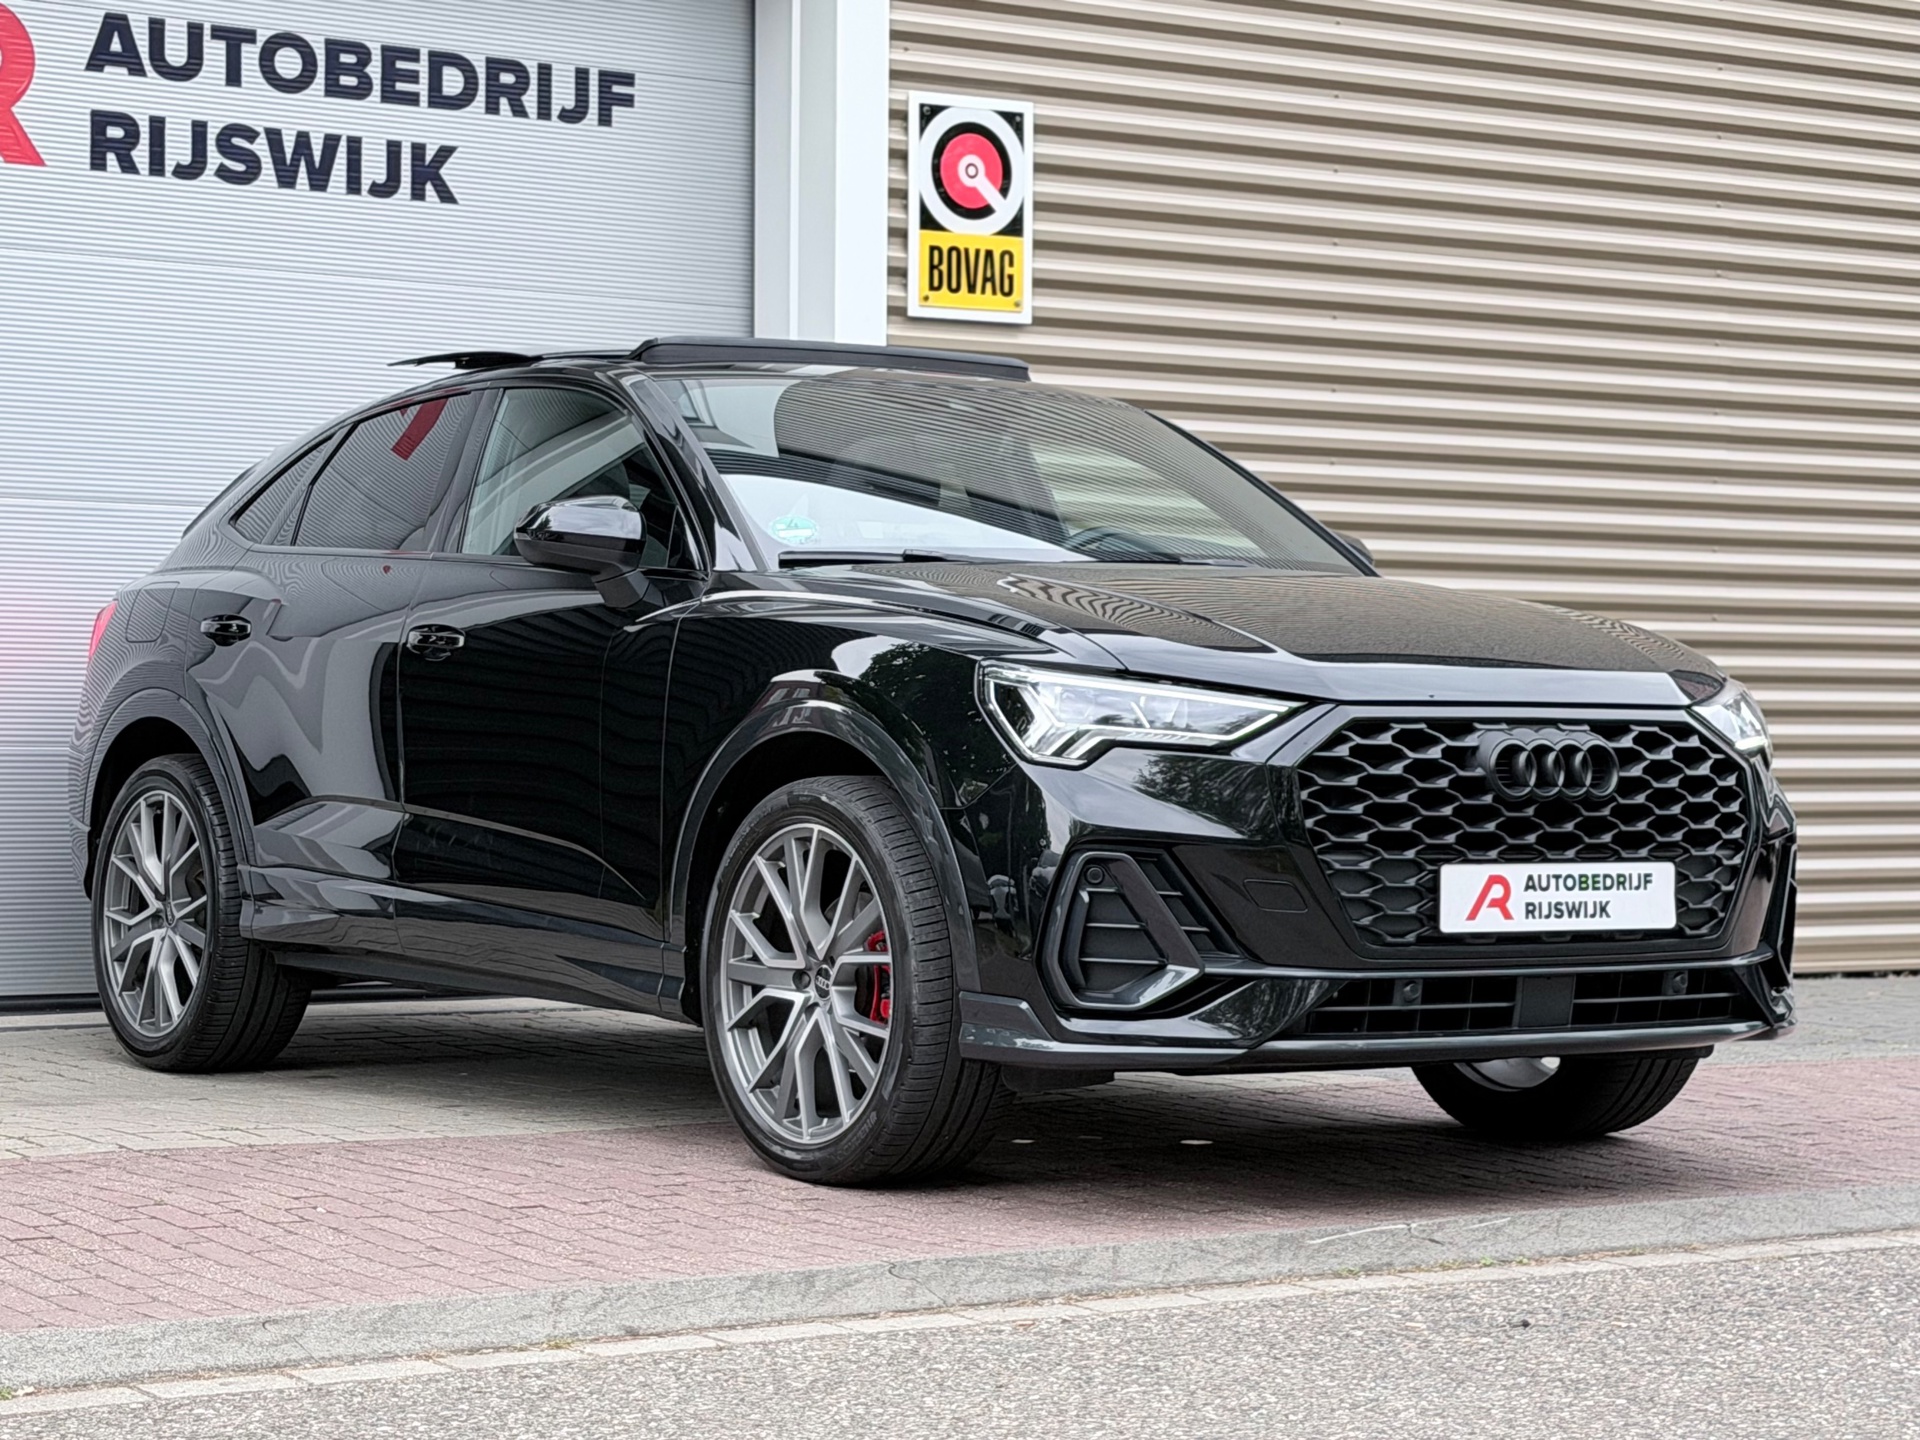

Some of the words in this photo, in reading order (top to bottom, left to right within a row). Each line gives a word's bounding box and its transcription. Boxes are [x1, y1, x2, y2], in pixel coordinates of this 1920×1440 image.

[84, 12, 636, 127] AUTOBEDRIJF
[89, 109, 459, 205] RIJSWIJK
[928, 245, 1014, 297] BOVAG
[1523, 873, 1653, 892] AUTOBEDRIJF
[1524, 900, 1611, 920] RIJSWIJK
